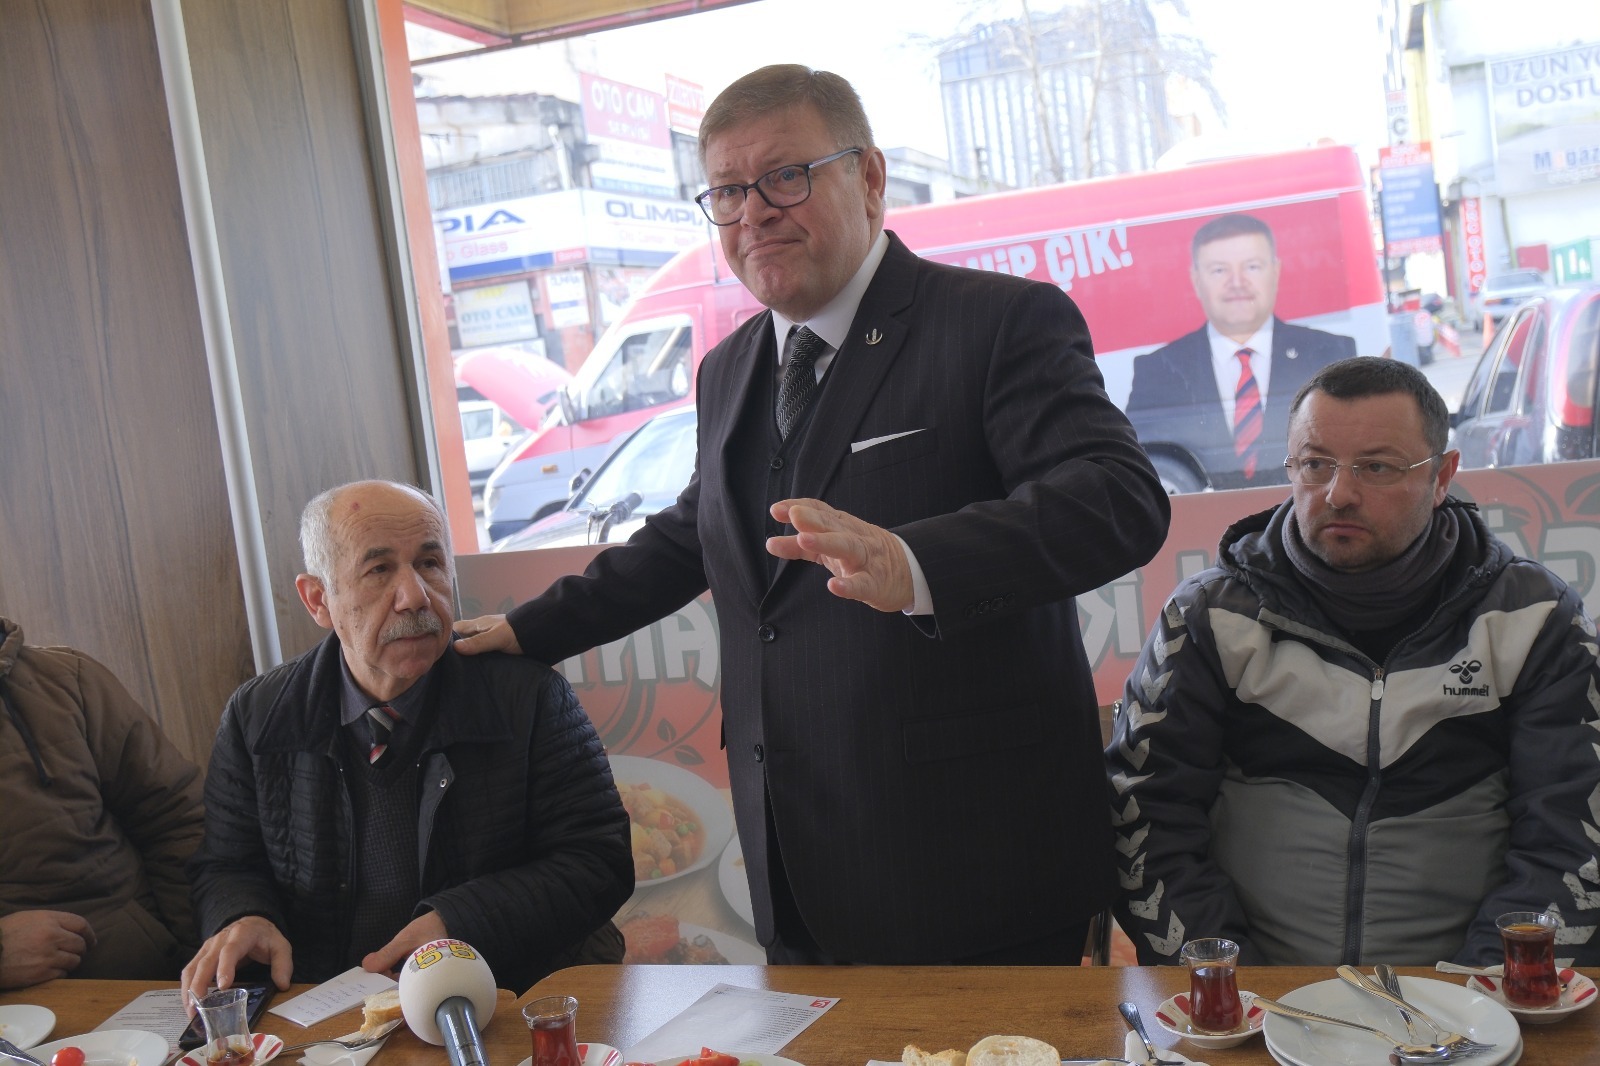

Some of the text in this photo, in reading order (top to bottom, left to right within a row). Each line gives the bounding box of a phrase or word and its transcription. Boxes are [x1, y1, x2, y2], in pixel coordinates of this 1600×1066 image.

[1493, 55, 1569, 86] UZUN
[591, 81, 622, 114] OTO
[626, 91, 656, 121] CAM
[460, 241, 509, 259] Glass
[1044, 224, 1134, 292] ÇIK!
[461, 304, 529, 324] OTO CAM
[1443, 684, 1489, 697] hummel
[415, 944, 477, 969] 55
